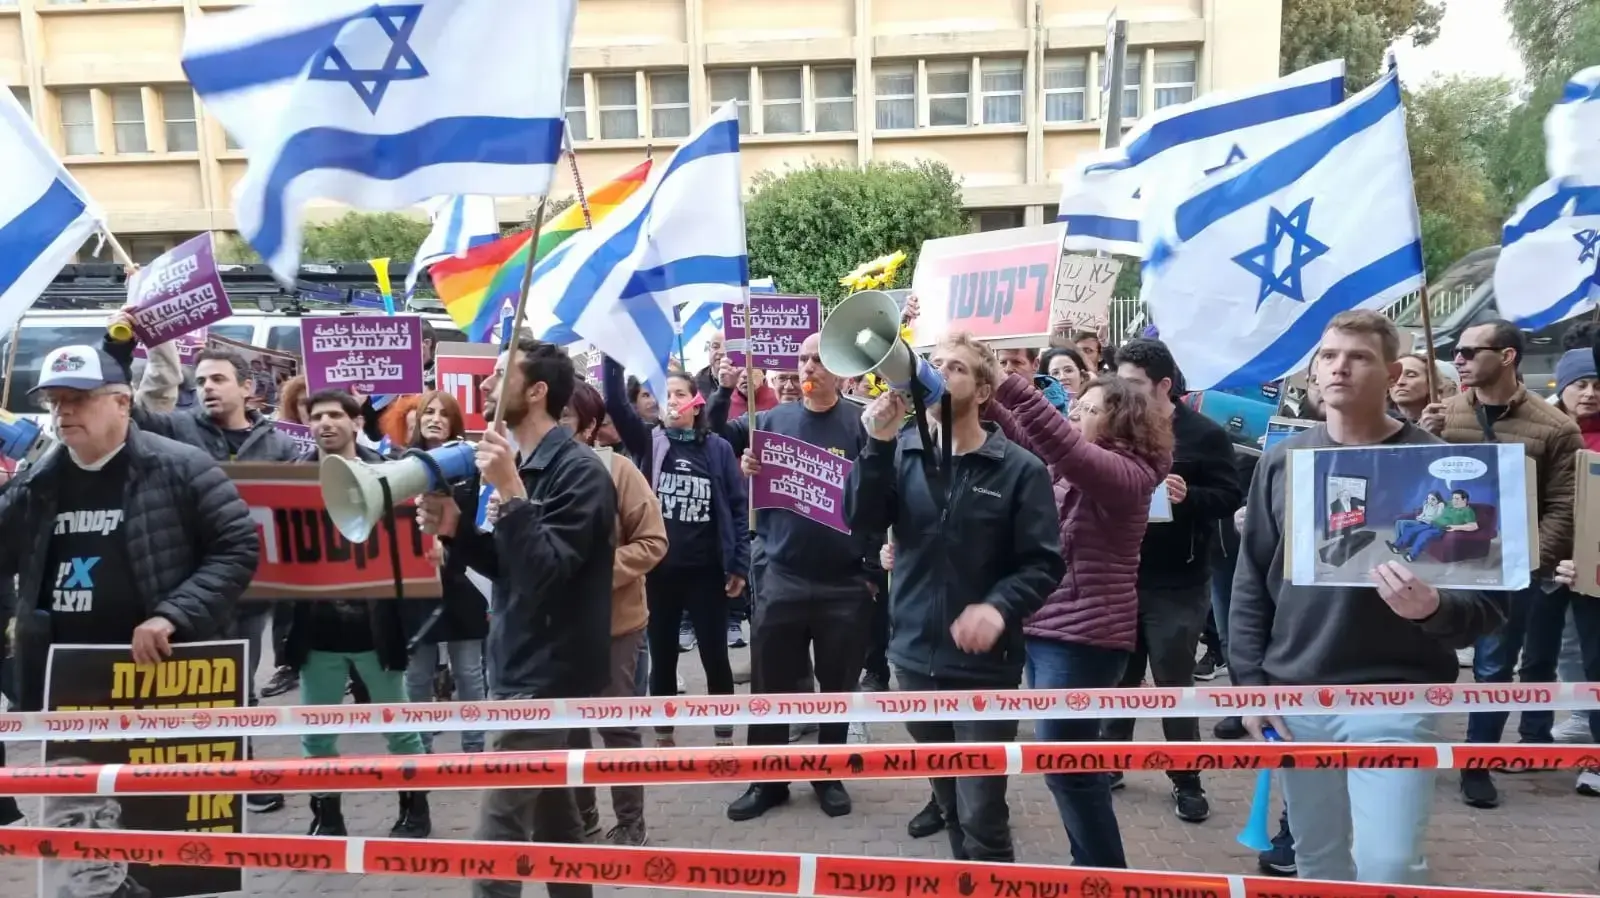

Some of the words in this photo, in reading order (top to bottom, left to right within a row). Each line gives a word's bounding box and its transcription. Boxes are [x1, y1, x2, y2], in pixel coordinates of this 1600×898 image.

[790, 315, 807, 327] לא
[316, 336, 385, 349] למיליציה
[389, 335, 408, 347] לא
[768, 344, 780, 355] בן
[328, 368, 357, 380] גביר
[361, 368, 375, 380] בן
[379, 364, 399, 378] של
[763, 451, 823, 477] למיליציה
[825, 470, 842, 485] לא
[772, 480, 798, 495] גביר
[801, 490, 813, 502] בן
[815, 490, 832, 508] של
[659, 493, 710, 521] בארצ
[111, 658, 235, 699] ממשלת
[996, 694, 1056, 711] ישראל
[1099, 693, 1176, 710] משטרת
[1209, 692, 1266, 708] מעבר
[1275, 692, 1303, 710] אין
[1345, 688, 1415, 706] ישראל
[1463, 688, 1552, 705] משטרת
[577, 705, 623, 719] מעבר
[629, 704, 652, 721] אין
[685, 701, 740, 717] ישראל
[778, 700, 847, 715] משטרת
[876, 698, 926, 713] מעבר
[934, 697, 958, 714] אין
[138, 713, 185, 730] ישראל
[217, 712, 277, 728] משטרת
[301, 711, 344, 725] מעבר
[350, 711, 371, 727] אין
[402, 707, 453, 723] ישראל
[487, 707, 550, 722] משטרת
[45, 718, 84, 732] מעבר
[89, 717, 109, 733] אין
[752, 754, 832, 775] ישראל
[883, 750, 916, 772] אין
[926, 752, 997, 770] מעבר
[1036, 753, 1133, 770] משטרת
[225, 850, 332, 870] משטרת
[374, 855, 449, 874] מעבר
[460, 856, 496, 877] אין
[550, 856, 631, 880] ישראל
[687, 865, 786, 886] משטרת
[828, 872, 895, 893] מעבר
[905, 874, 939, 897] אין
[990, 874, 1068, 898] ישראל
